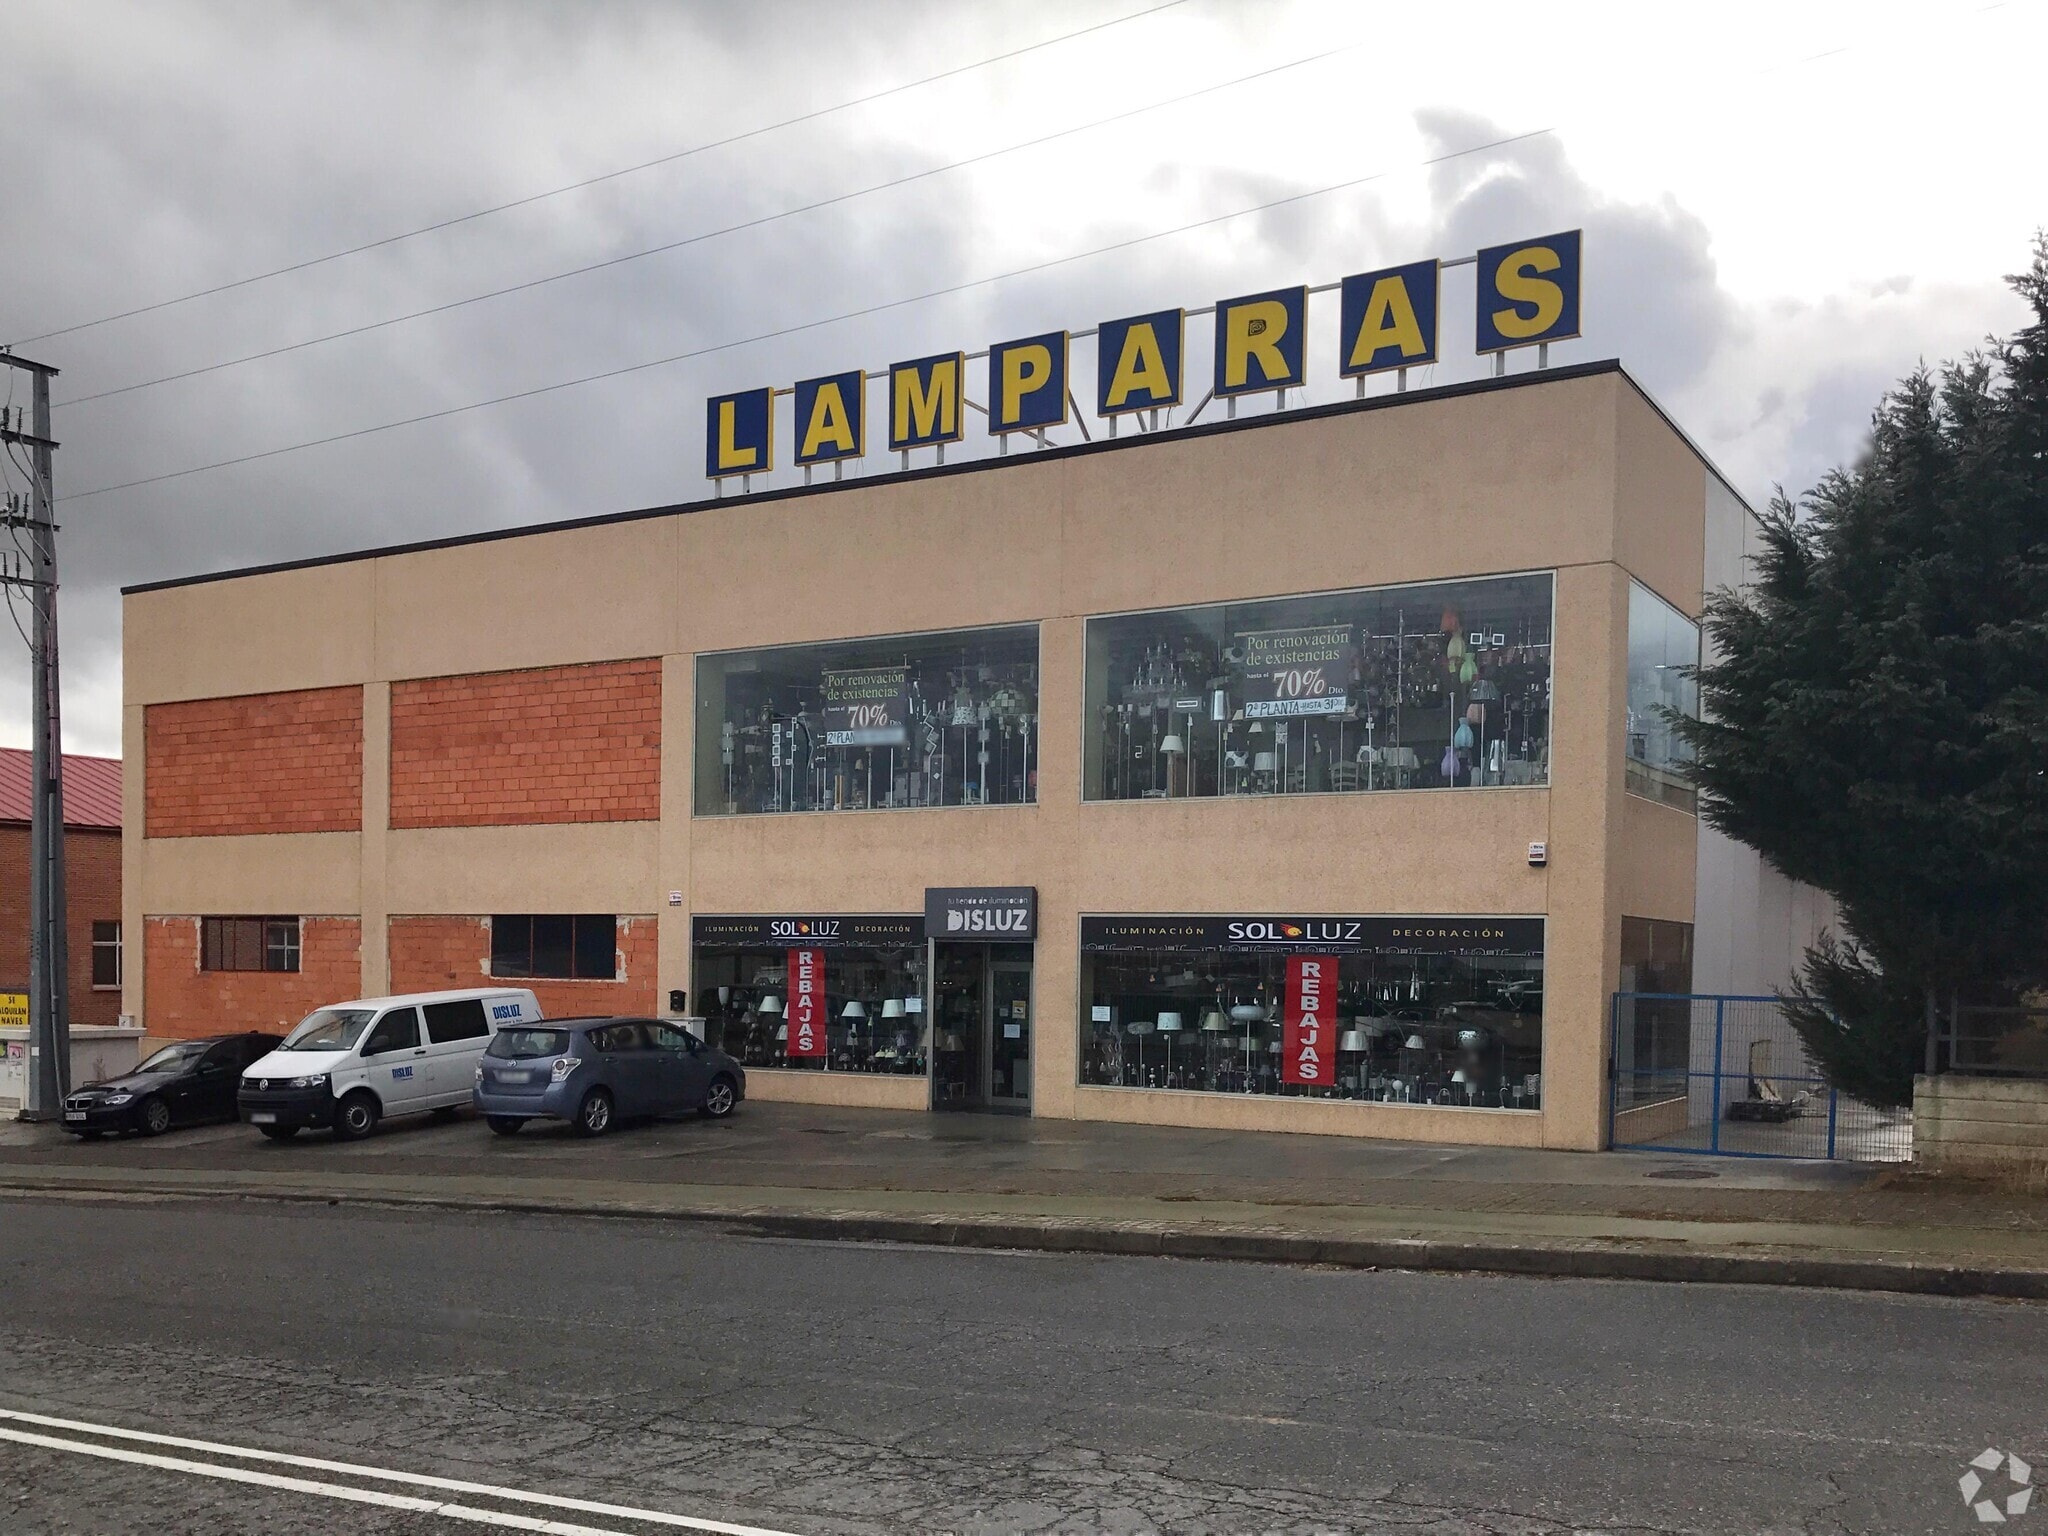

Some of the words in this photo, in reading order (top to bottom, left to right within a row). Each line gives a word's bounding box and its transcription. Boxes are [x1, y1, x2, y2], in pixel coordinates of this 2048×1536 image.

[719, 246, 1564, 470] LAMPARAS
[1247, 636, 1269, 650] Por
[1274, 629, 1349, 649] renovación
[1246, 652, 1261, 666] de
[1265, 646, 1340, 664] existencias
[828, 675, 845, 687] Por
[848, 670, 905, 686] renovación
[1273, 667, 1325, 698] 70%
[827, 688, 840, 701] de
[842, 684, 899, 700] existencias
[847, 703, 888, 728] 70%
[1260, 701, 1300, 716] PLANTA
[978, 896, 987, 905] de
[705, 924, 759, 933] ILUMINACIÓN
[771, 921, 799, 936] SOL
[811, 921, 840, 936] LUZ
[854, 924, 911, 933] DECORACIÓN
[947, 908, 1028, 931] DISLUZ
[1105, 926, 1204, 935] ILUMINACIÓN
[1228, 922, 1283, 940] SOL
[1306, 922, 1362, 940] LUZ
[1392, 927, 1505, 938] DECORACIÓN
[798, 951, 814, 1051] REBAJAS
[1, 1017, 23, 1025] NAVES
[492, 1004, 522, 1020] DISLUZ
[1298, 962, 1322, 1079] REBAJAS
[391, 1066, 414, 1079] DISLUZ
